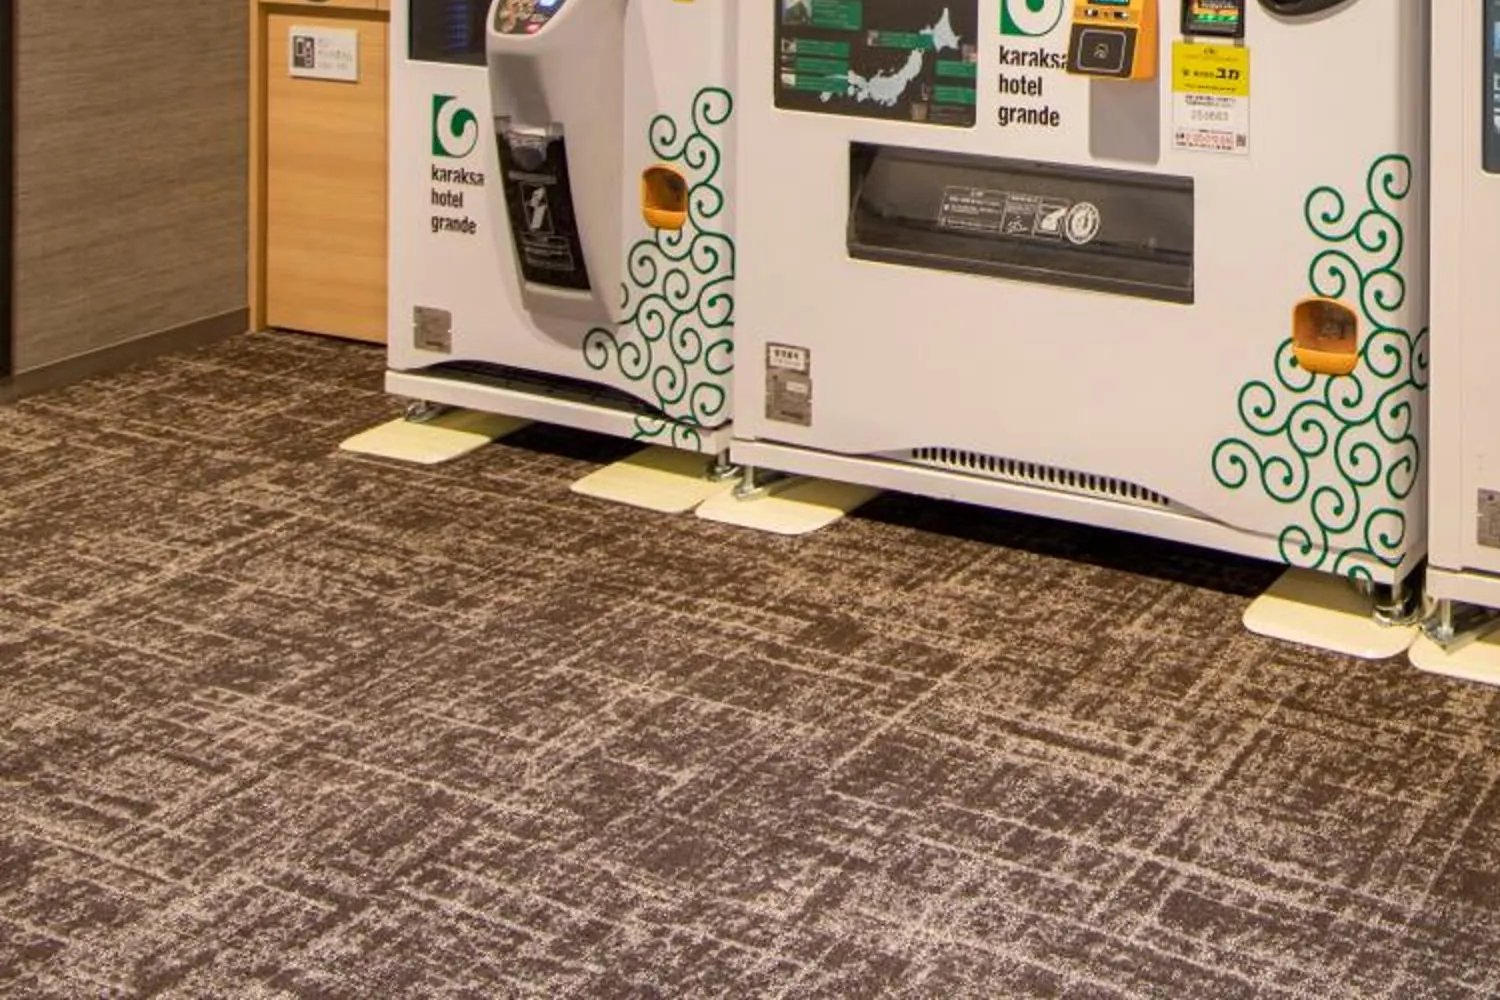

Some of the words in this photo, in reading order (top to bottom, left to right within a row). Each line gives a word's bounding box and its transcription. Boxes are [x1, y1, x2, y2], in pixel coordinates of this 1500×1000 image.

[999, 73, 1042, 97] hotel
[998, 105, 1060, 127] grande
[431, 164, 485, 186] karaksa
[431, 188, 464, 208] hotel
[431, 215, 477, 235] grande
